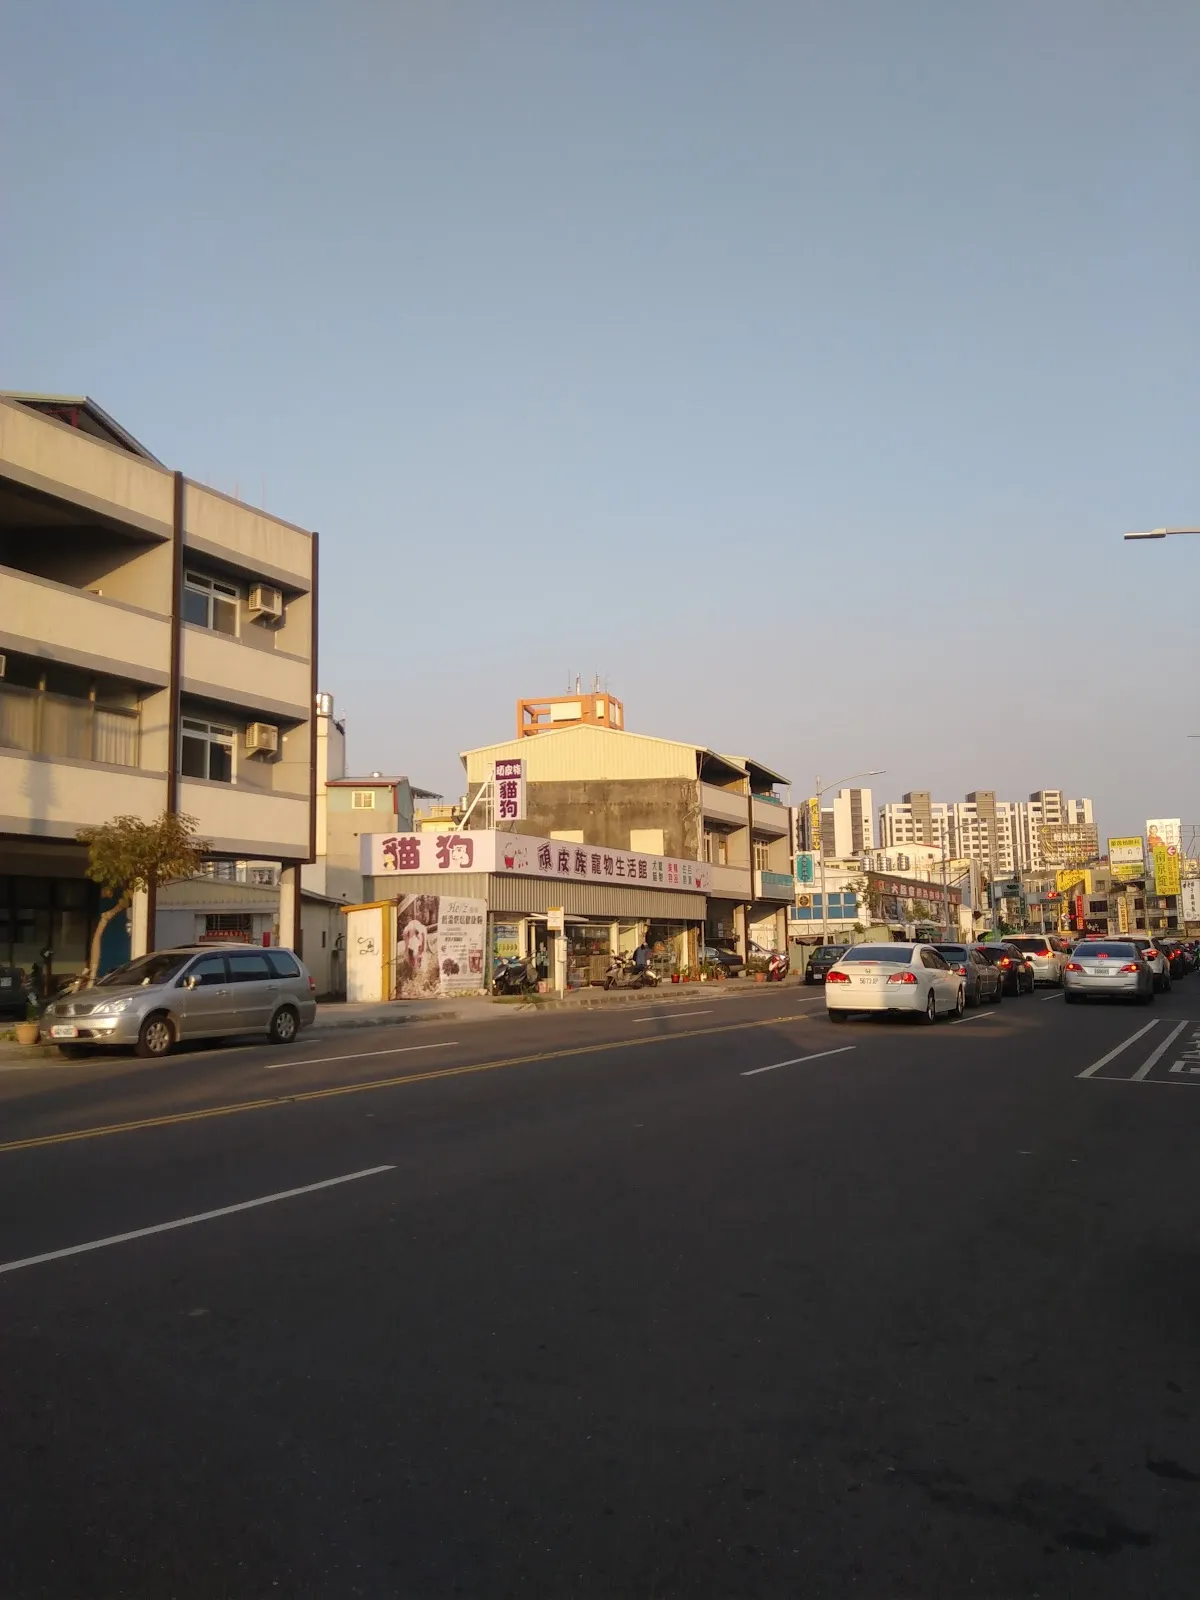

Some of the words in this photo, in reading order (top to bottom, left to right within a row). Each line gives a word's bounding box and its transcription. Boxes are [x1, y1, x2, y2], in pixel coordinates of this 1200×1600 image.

[496, 763, 521, 776] 頑皮族
[499, 780, 518, 819] 貓狗
[382, 835, 474, 871] 貓狗
